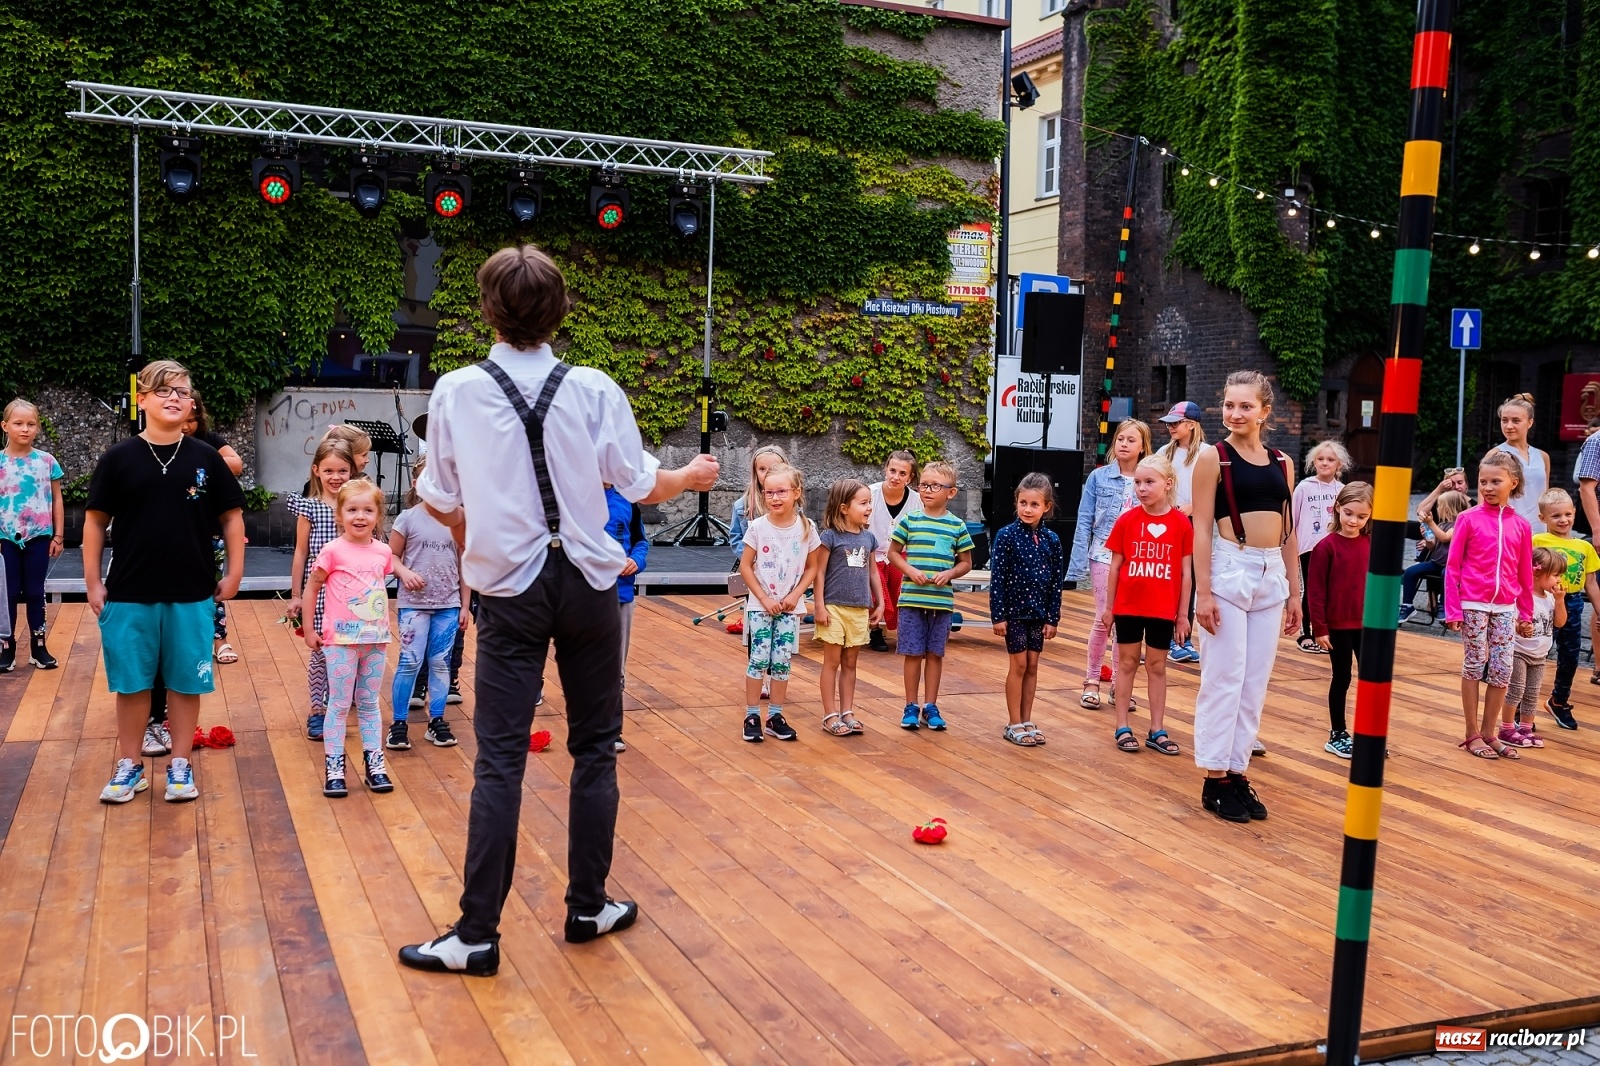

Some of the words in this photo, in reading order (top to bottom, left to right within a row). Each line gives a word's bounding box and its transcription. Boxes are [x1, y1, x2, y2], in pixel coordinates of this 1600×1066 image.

[865, 300, 880, 312] Plac
[881, 301, 910, 315] Księżnej
[911, 303, 925, 314] Ofki
[925, 304, 958, 317] Piastówny
[1017, 378, 1076, 396] Racibrskie
[1131, 540, 1173, 561] DEBUT
[1128, 560, 1172, 580] DANCE
[336, 622, 359, 631] ALOHA
